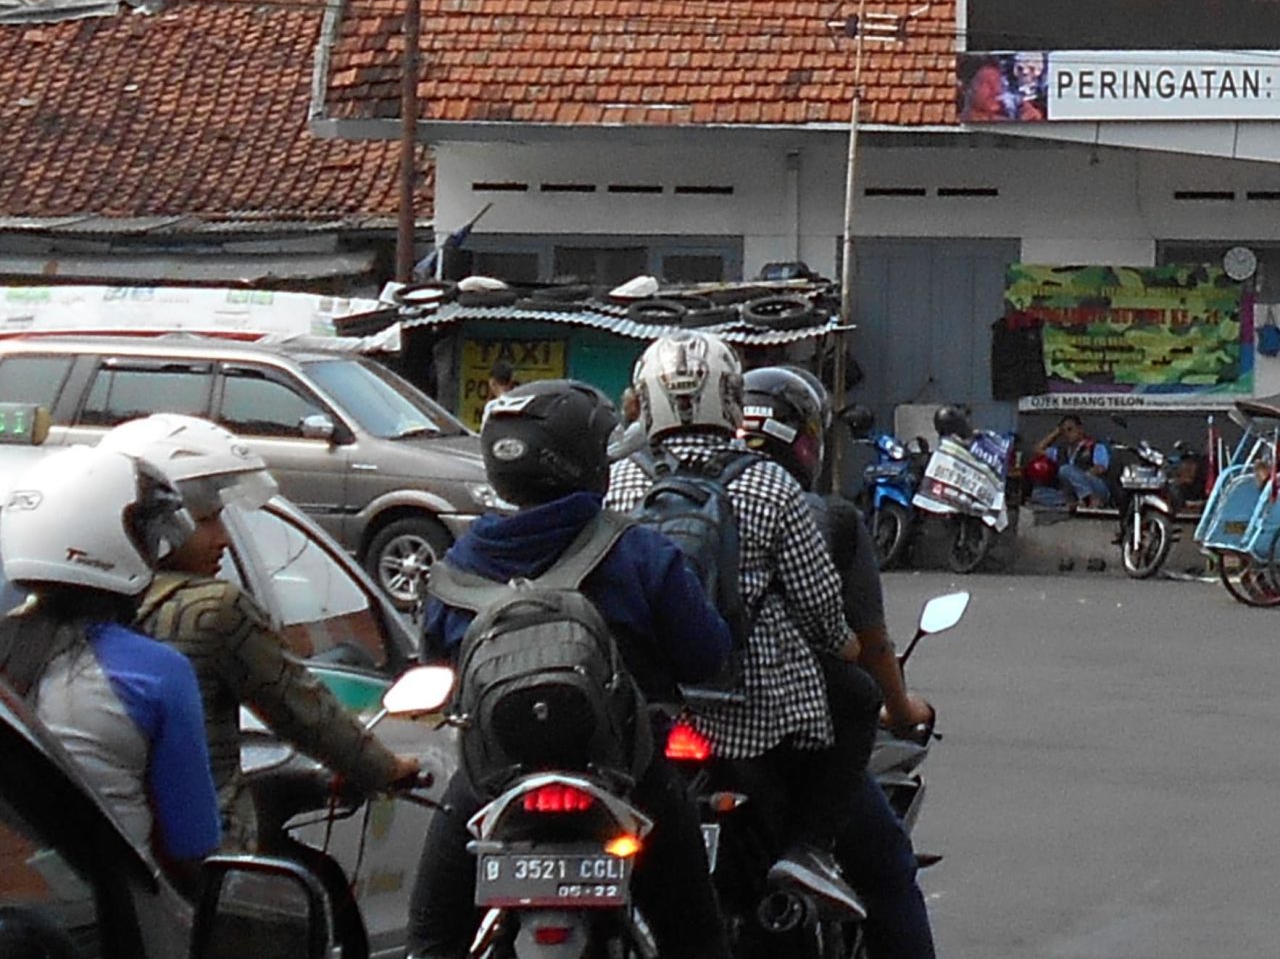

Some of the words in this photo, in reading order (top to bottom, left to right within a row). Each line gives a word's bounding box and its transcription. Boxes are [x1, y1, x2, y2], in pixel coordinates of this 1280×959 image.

[1057, 70, 1272, 99] PERINGATAN:
[476, 341, 552, 365] TAXI
[487, 860, 499, 881] B
[515, 859, 566, 879] 3521
